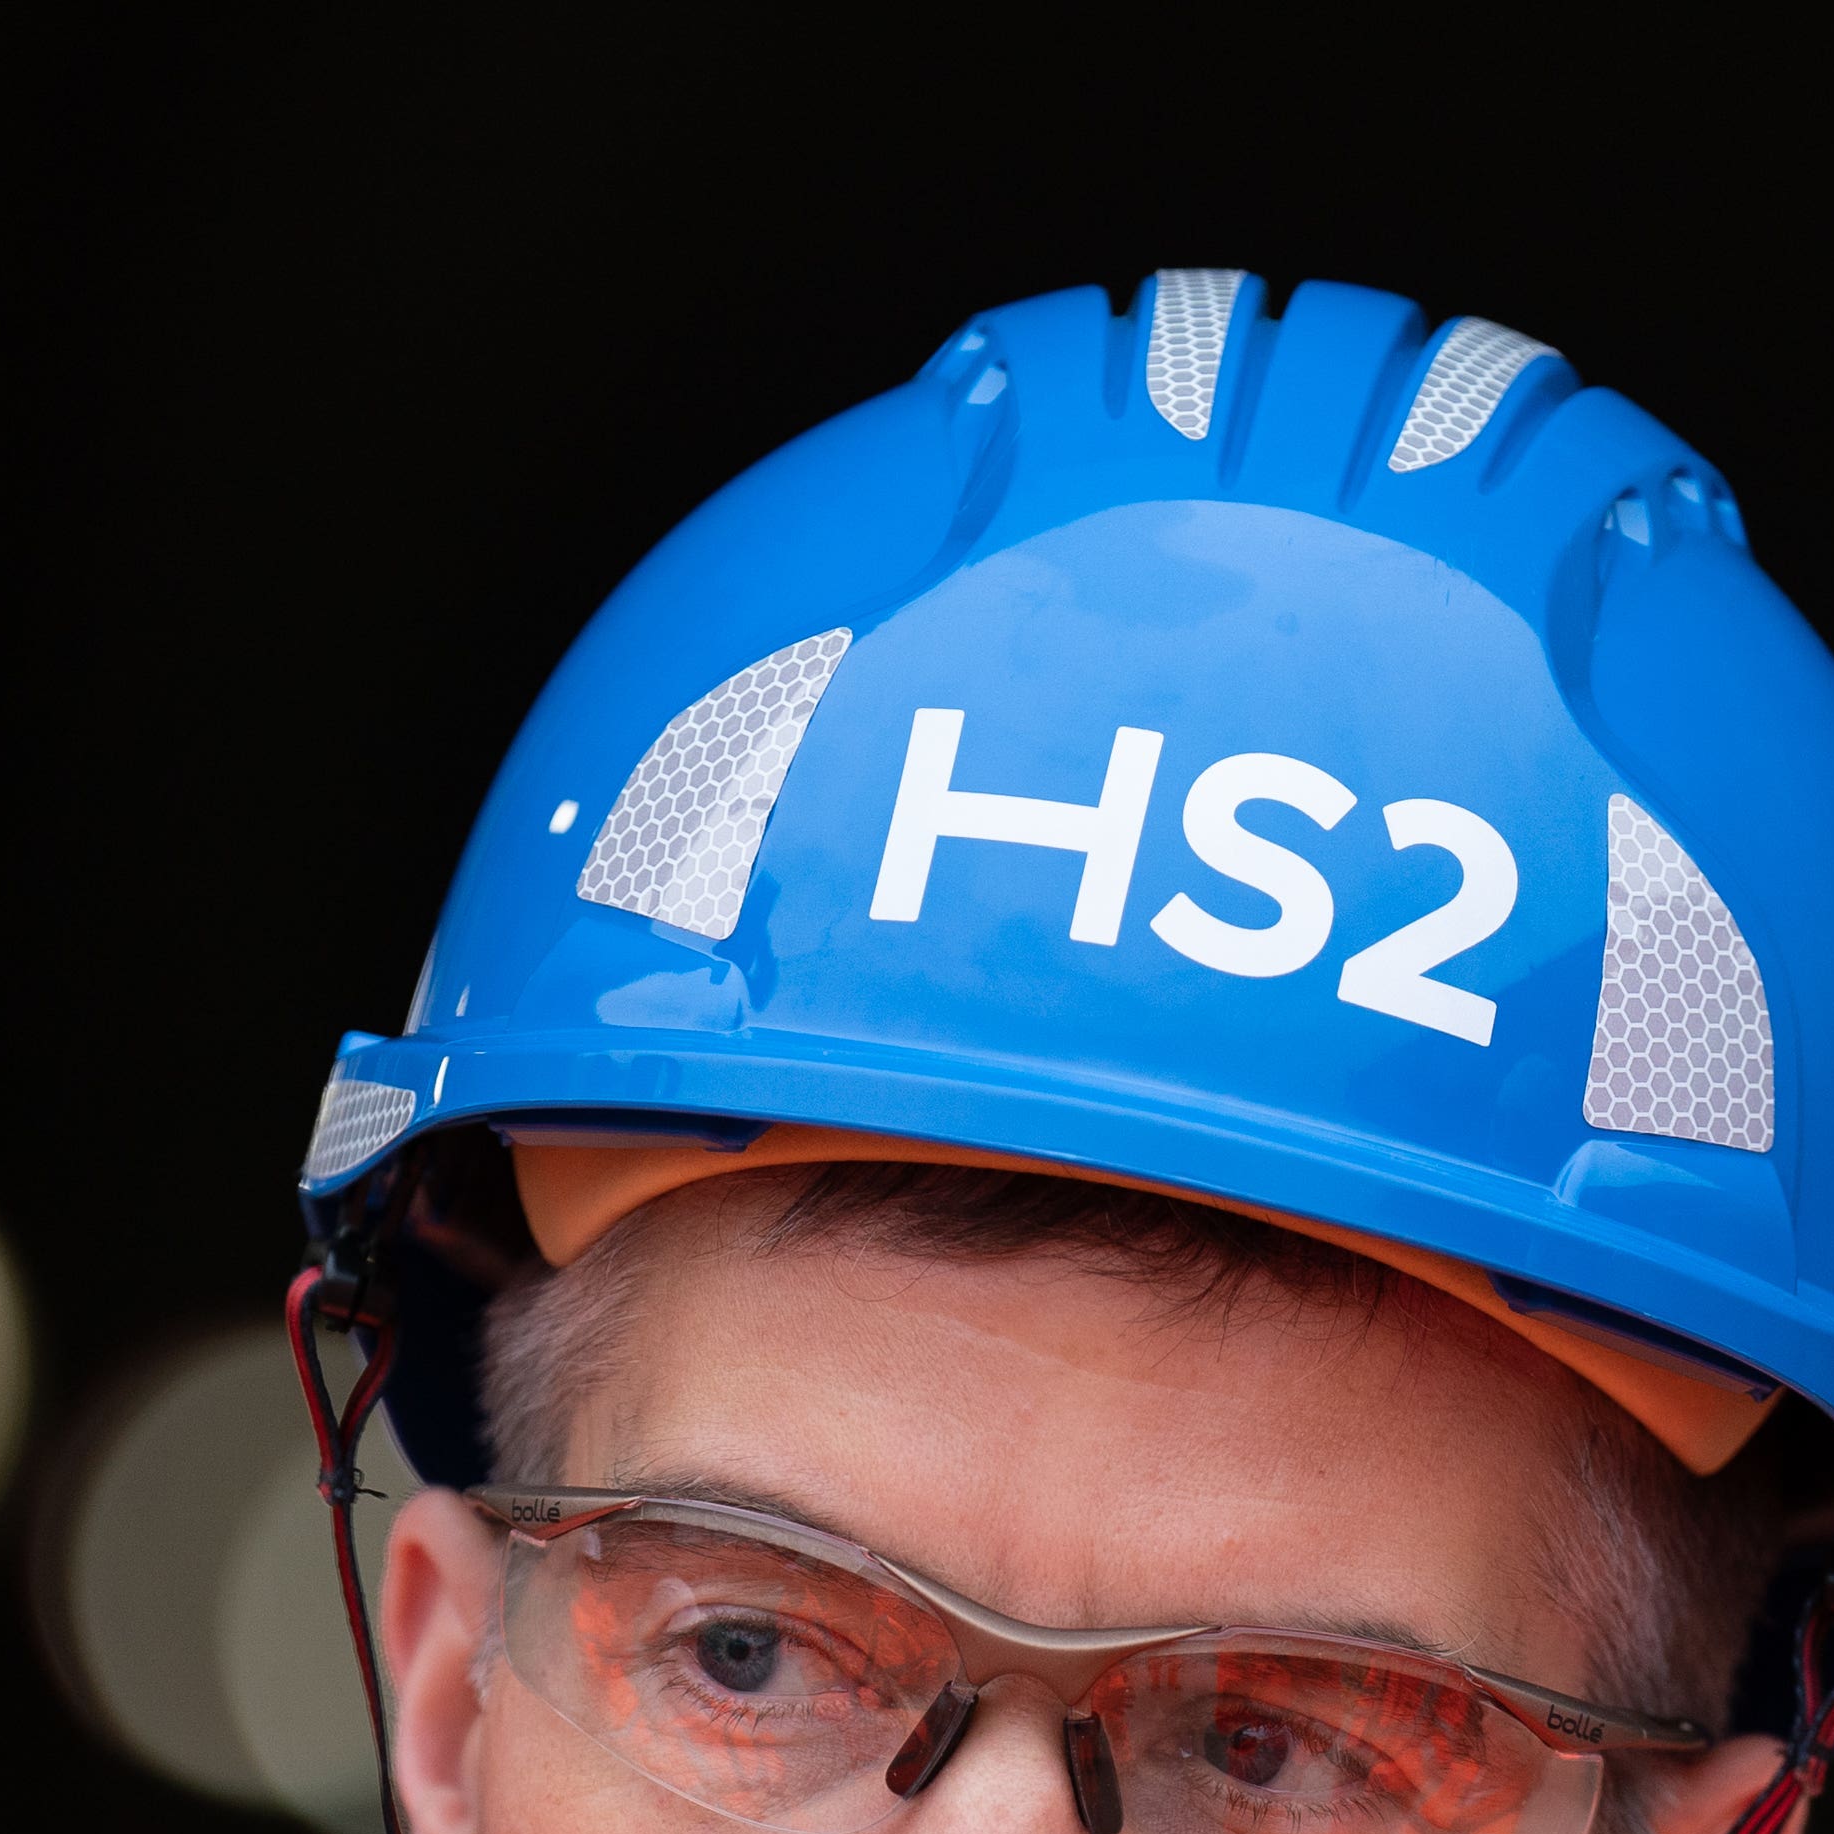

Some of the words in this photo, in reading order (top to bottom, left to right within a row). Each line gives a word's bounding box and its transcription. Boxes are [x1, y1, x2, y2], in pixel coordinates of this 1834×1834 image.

[869, 707, 1518, 1047] HS2
[511, 1498, 561, 1523] bollé
[1546, 1704, 1605, 1744] bollé
